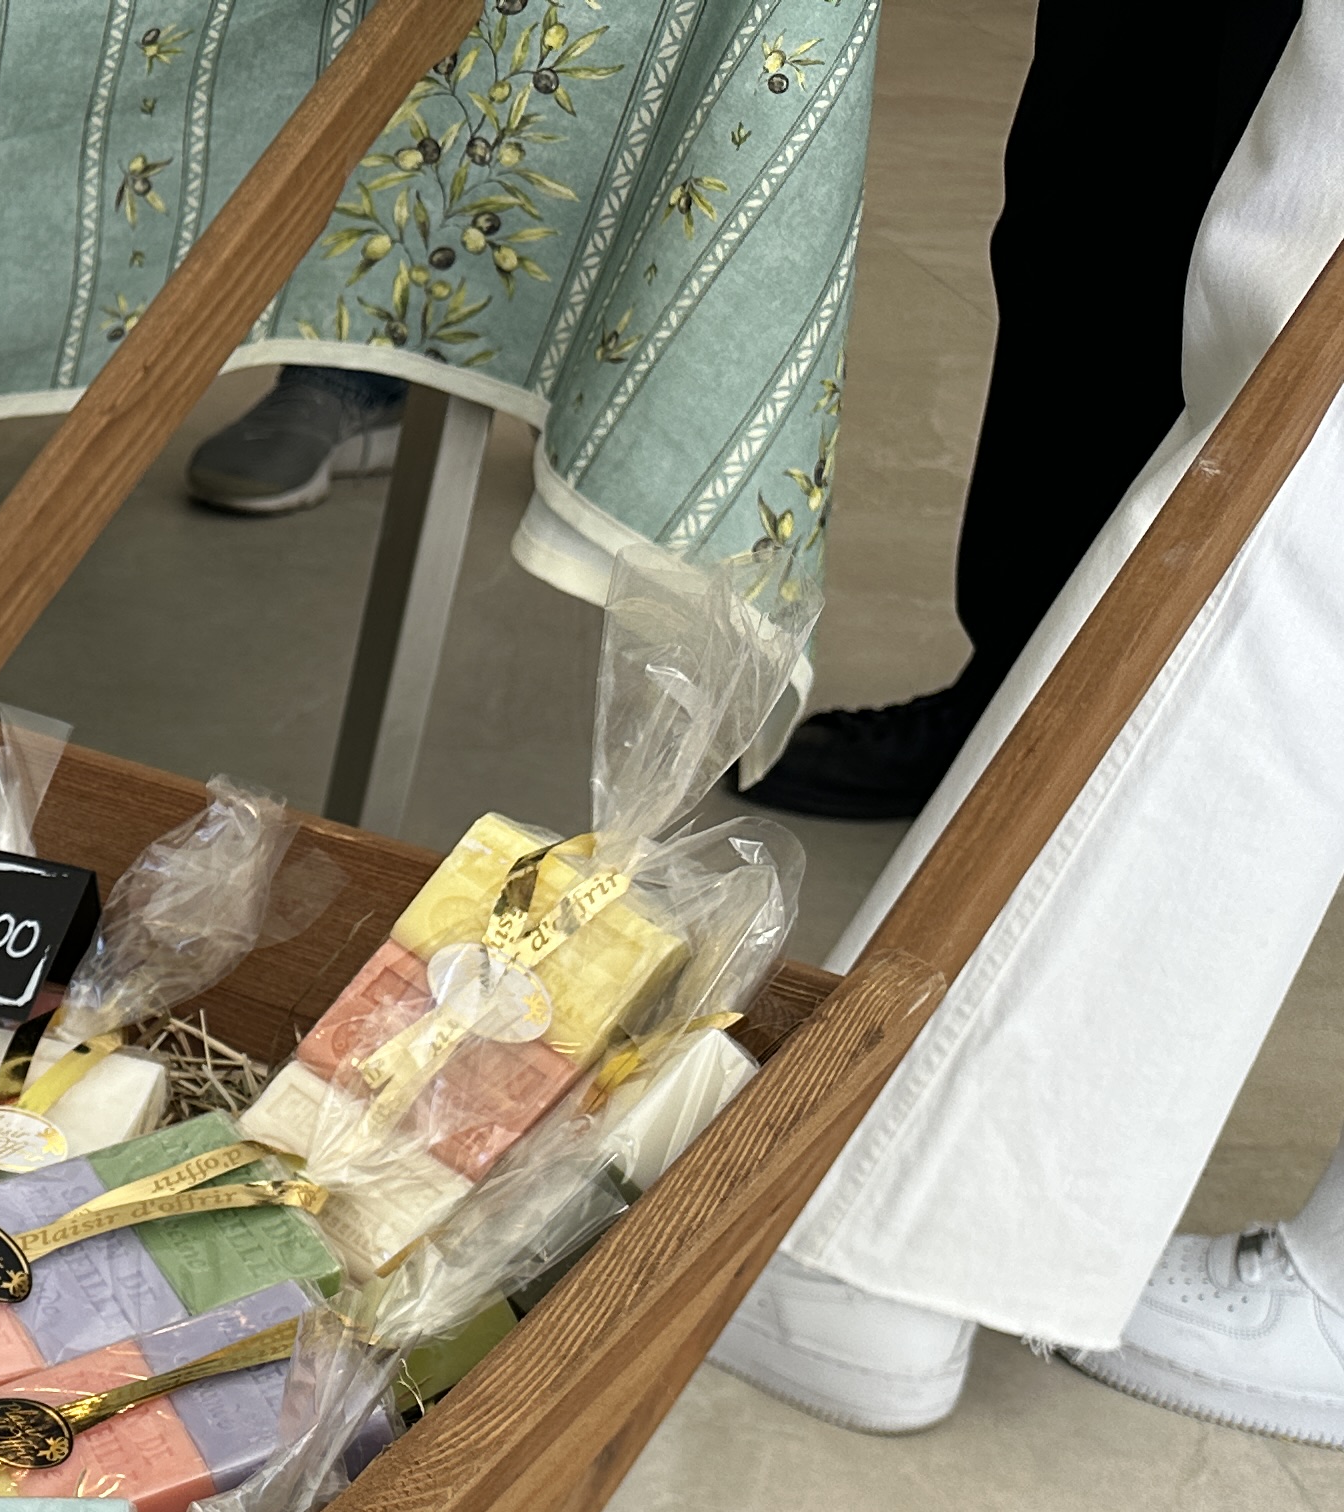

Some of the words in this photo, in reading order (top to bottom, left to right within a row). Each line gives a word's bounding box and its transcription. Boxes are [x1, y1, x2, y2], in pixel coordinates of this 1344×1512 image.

[151, 1148, 243, 1195] d'offrir
[18, 1209, 120, 1252] Plaisir
[130, 1189, 238, 1219] d'offrir
